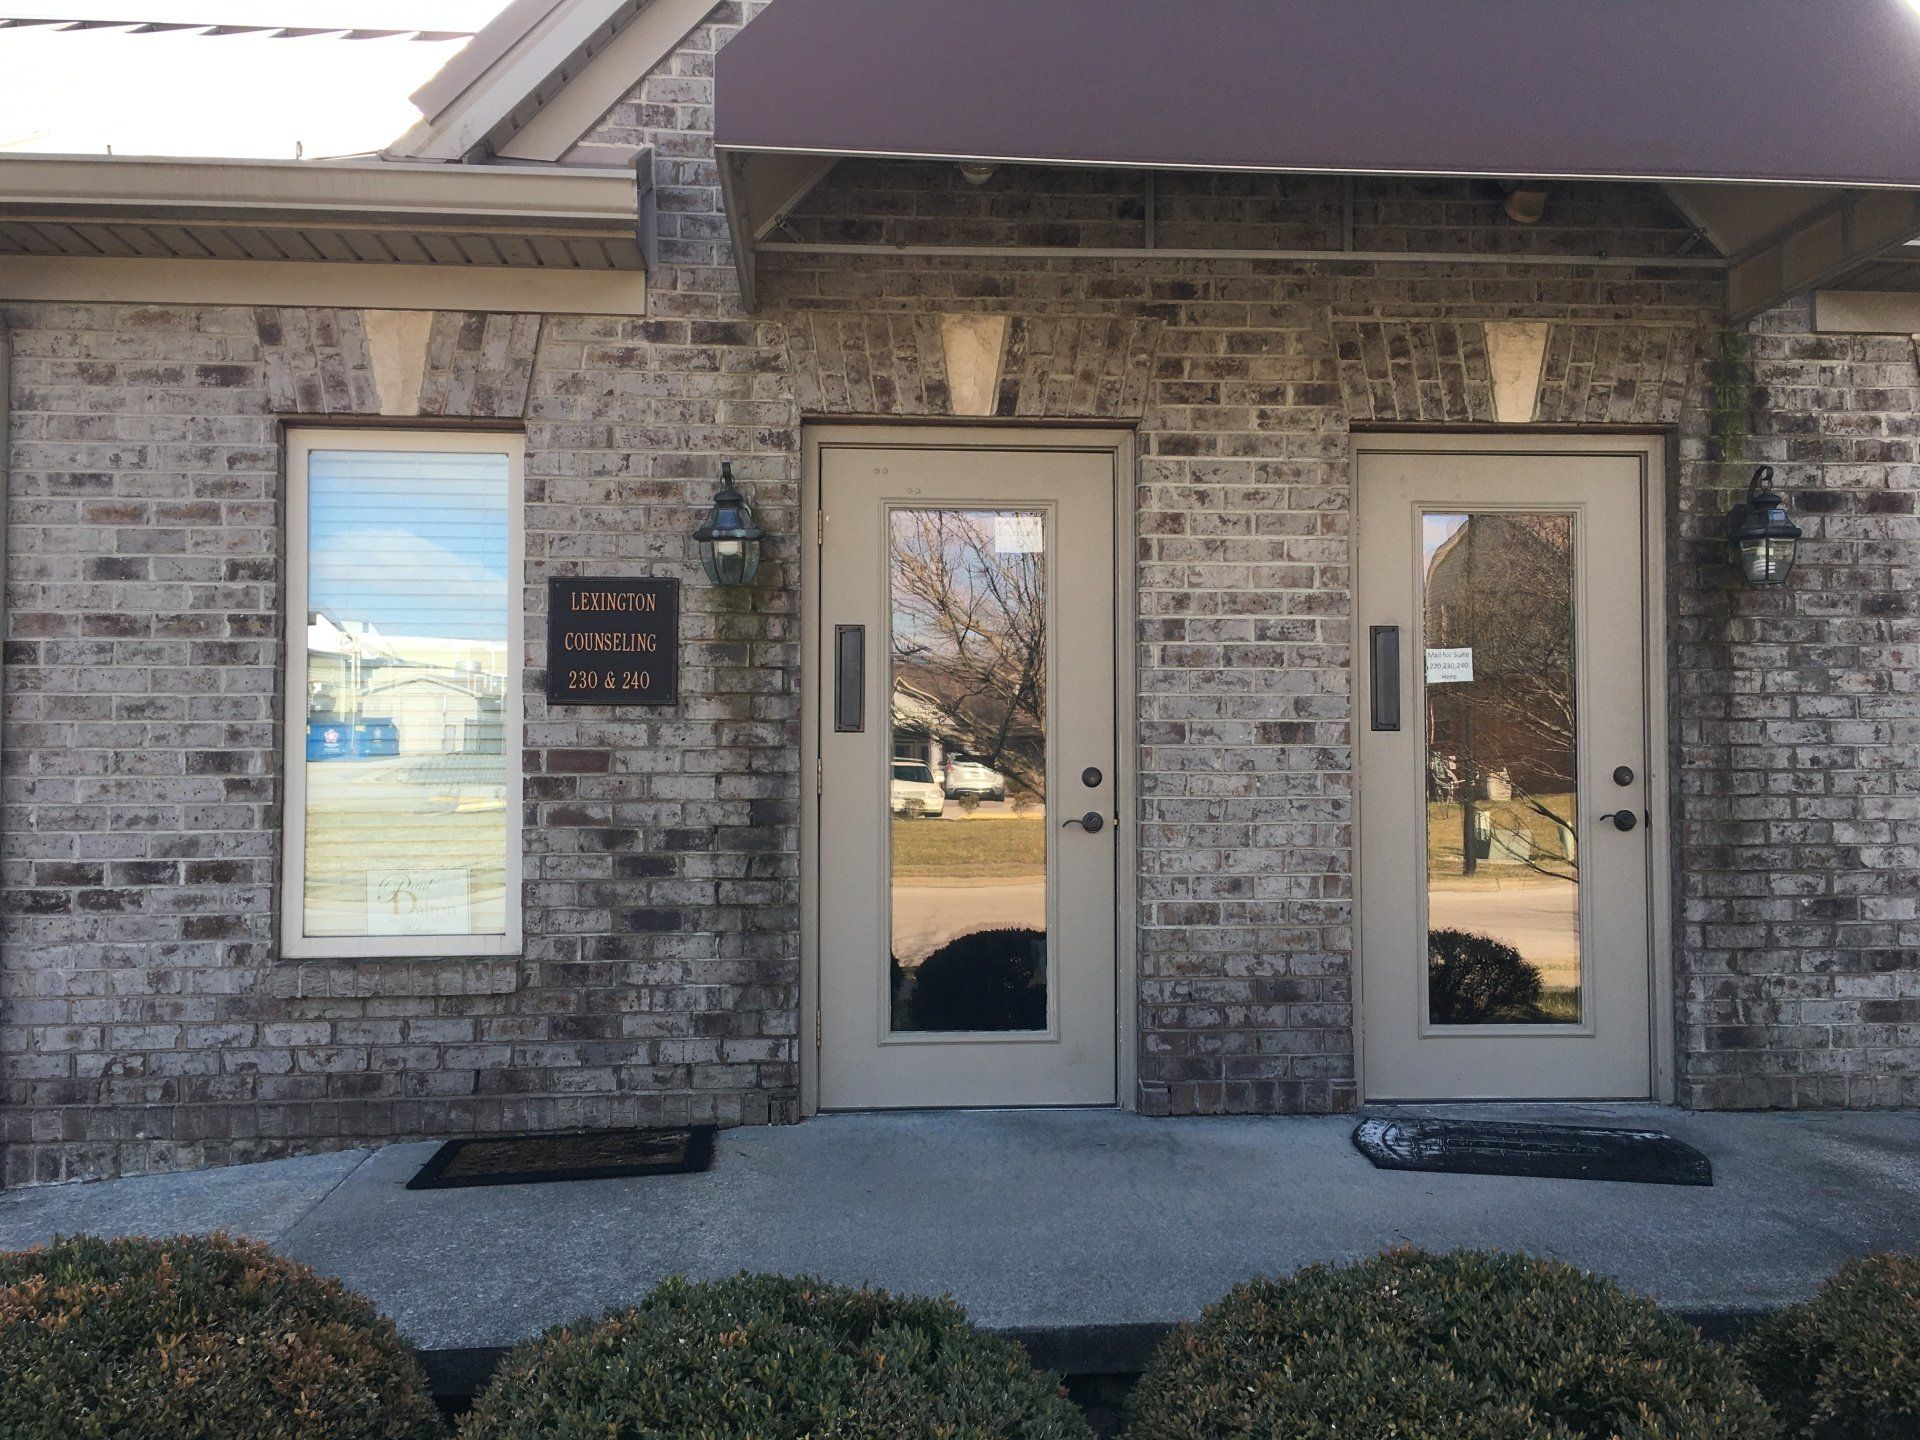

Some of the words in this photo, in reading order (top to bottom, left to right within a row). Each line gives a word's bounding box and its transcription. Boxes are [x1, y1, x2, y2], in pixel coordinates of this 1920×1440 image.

[571, 592, 656, 611] LEXINGTON
[564, 632, 657, 652] COUNSELING
[568, 670, 598, 689] 230
[604, 671, 616, 689] &
[622, 671, 650, 689] 240
